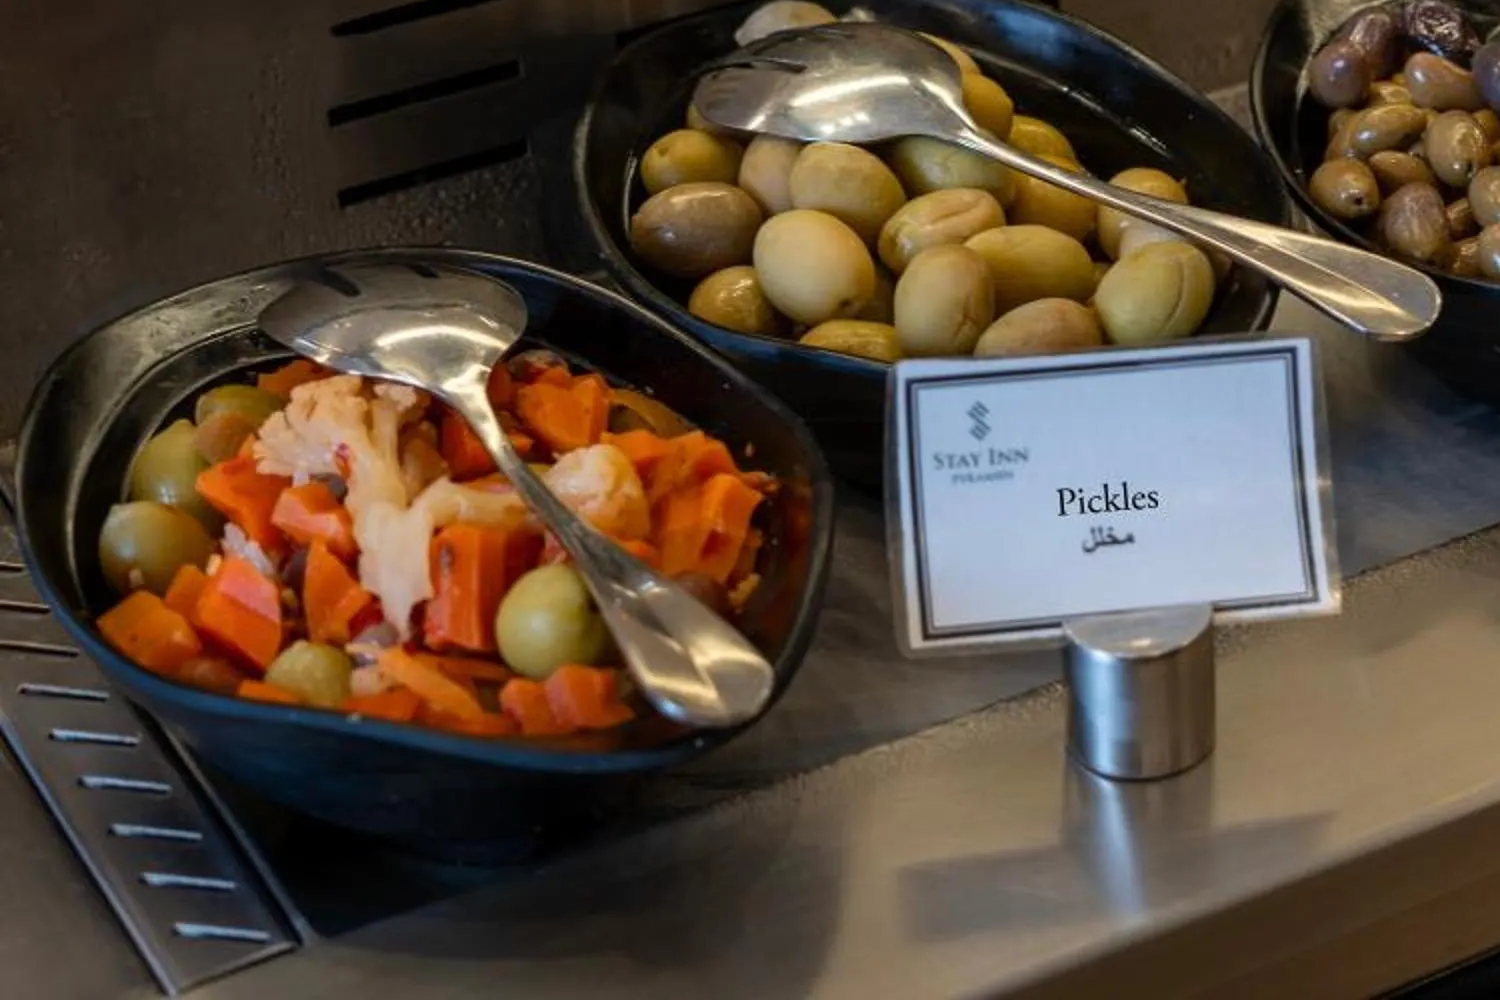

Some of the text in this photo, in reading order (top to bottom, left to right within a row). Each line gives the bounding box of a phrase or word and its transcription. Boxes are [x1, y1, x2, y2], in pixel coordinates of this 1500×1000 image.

[933, 447, 1030, 471] STAY INN
[1056, 480, 1160, 516] Pickles
[1082, 526, 1136, 553] مخلل
